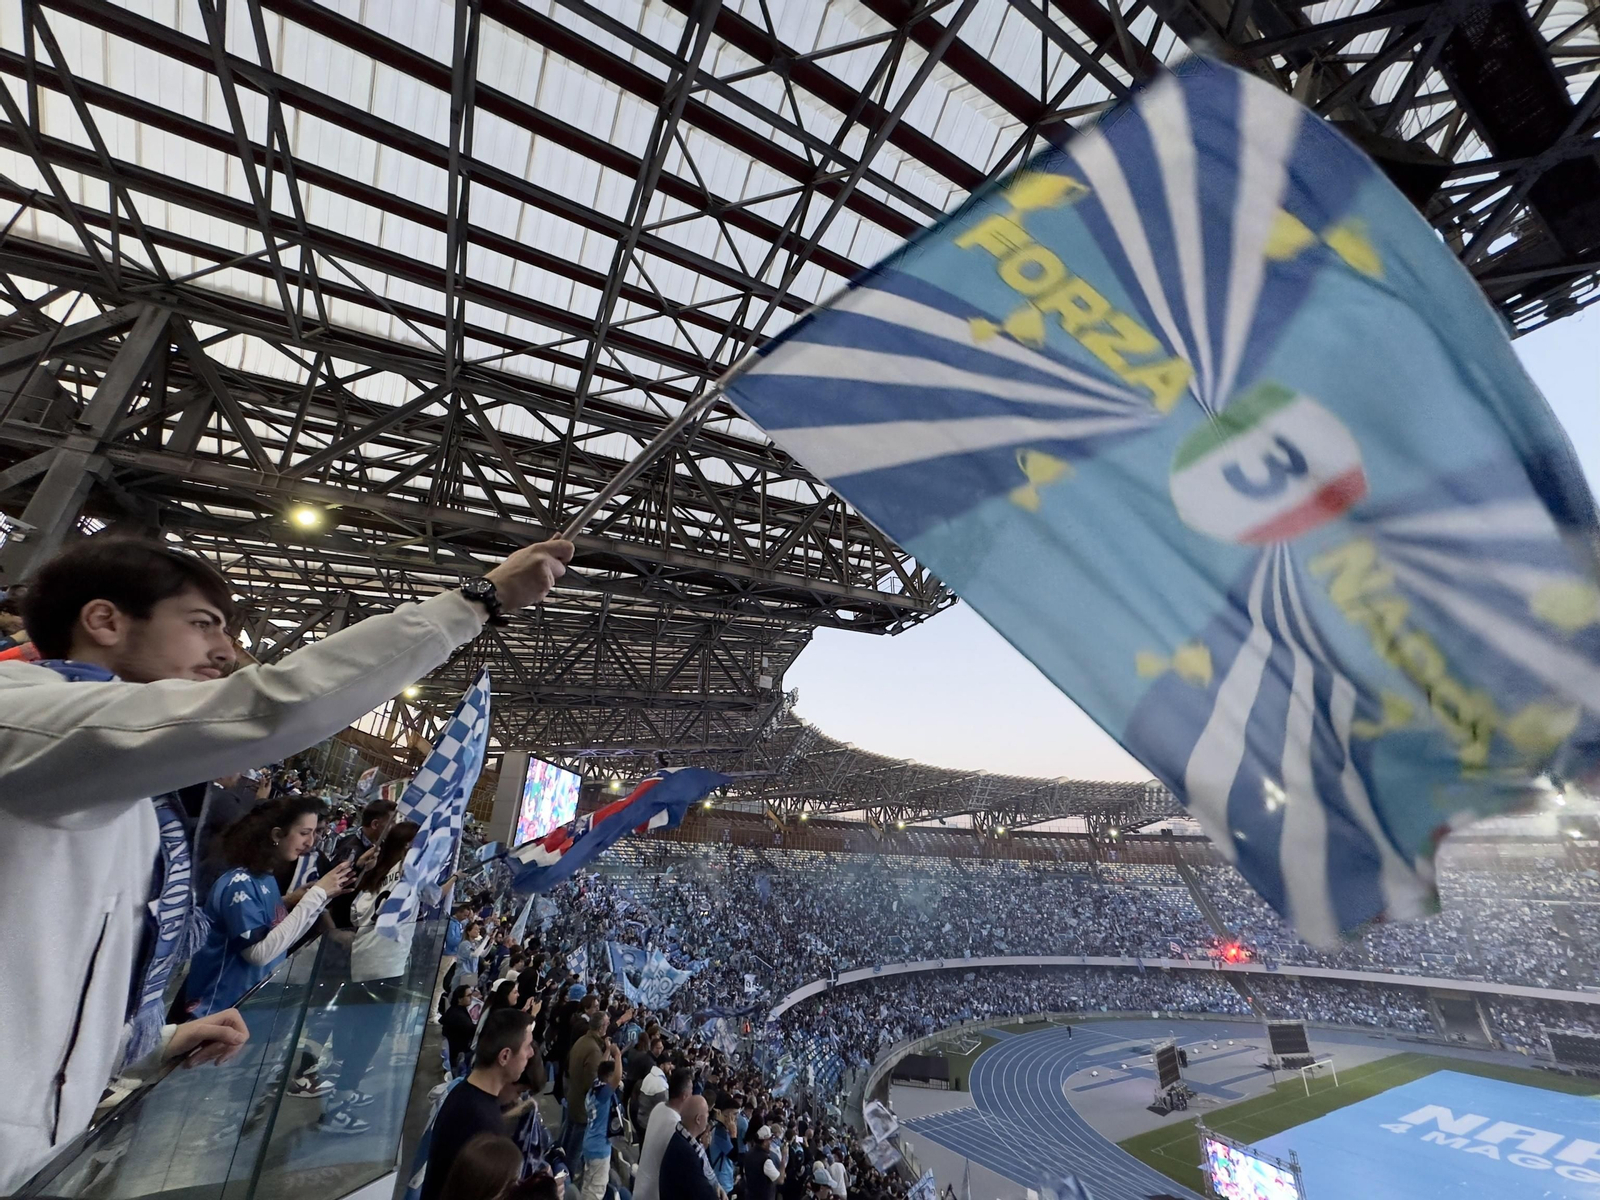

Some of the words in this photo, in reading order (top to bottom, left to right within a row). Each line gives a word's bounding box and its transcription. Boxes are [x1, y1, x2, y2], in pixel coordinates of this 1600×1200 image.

[954, 213, 1192, 414] FORZA
[1221, 433, 1309, 499] 3
[160, 820, 192, 942] GIORNO
[1379, 1123, 1413, 1134] 4
[1420, 1131, 1600, 1183] MAGG
